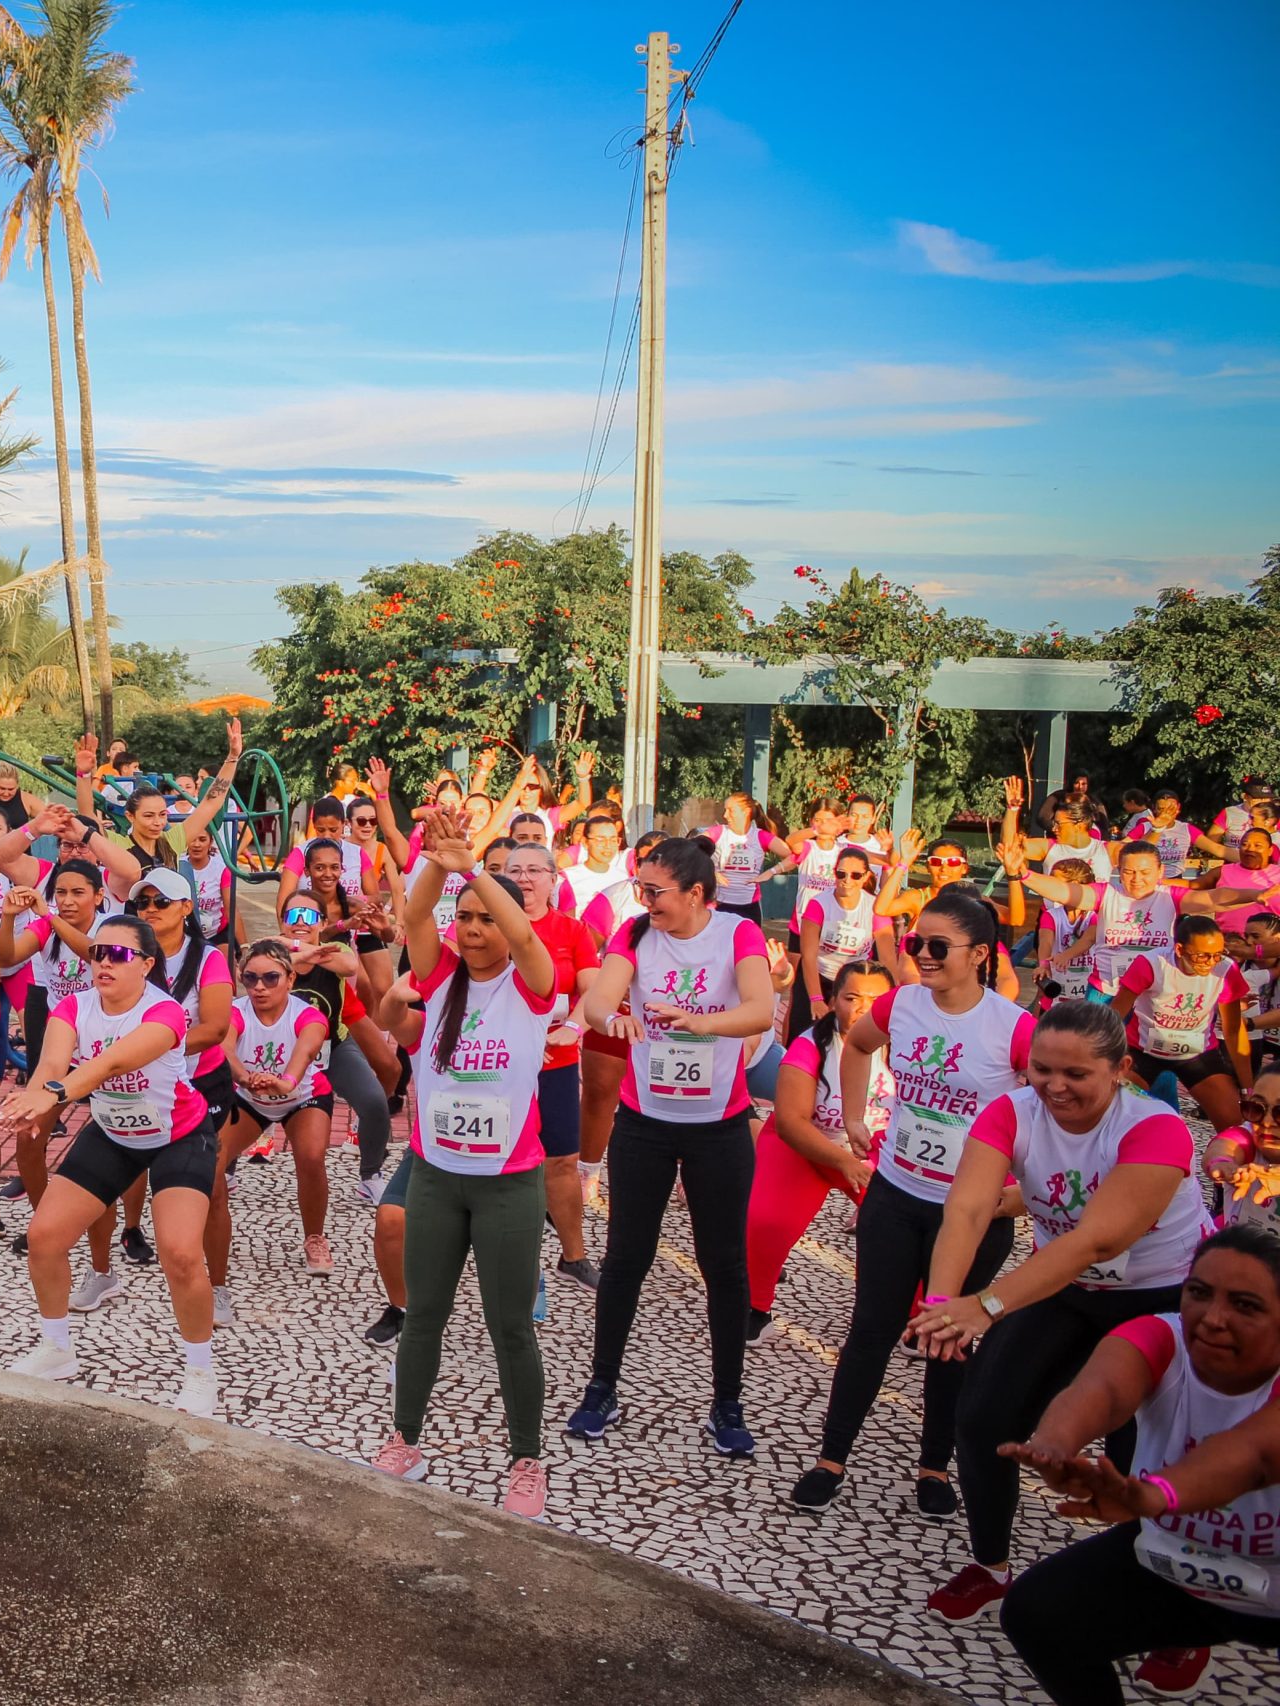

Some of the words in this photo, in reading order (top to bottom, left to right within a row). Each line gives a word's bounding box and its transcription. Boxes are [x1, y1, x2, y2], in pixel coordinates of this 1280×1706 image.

[732, 856, 750, 866] 235
[1105, 928, 1153, 937] CORRIDA
[835, 933, 858, 948] 213
[1104, 935, 1169, 948] MULHER
[50, 979, 89, 991] CORRIDA
[1070, 985, 1086, 996] 44
[1153, 1016, 1201, 1030] MULH
[1154, 1011, 1199, 1023] CORRIDA
[486, 1039, 507, 1051] DA
[1170, 1042, 1190, 1054] 30
[126, 1070, 145, 1083] DA
[674, 1062, 701, 1082] 26
[101, 1079, 150, 1094] LHER
[956, 1088, 978, 1100] DA
[114, 1115, 153, 1129] 228
[452, 1115, 494, 1138] 241
[916, 1139, 947, 1167] 22
[1080, 1265, 1123, 1282] 34
